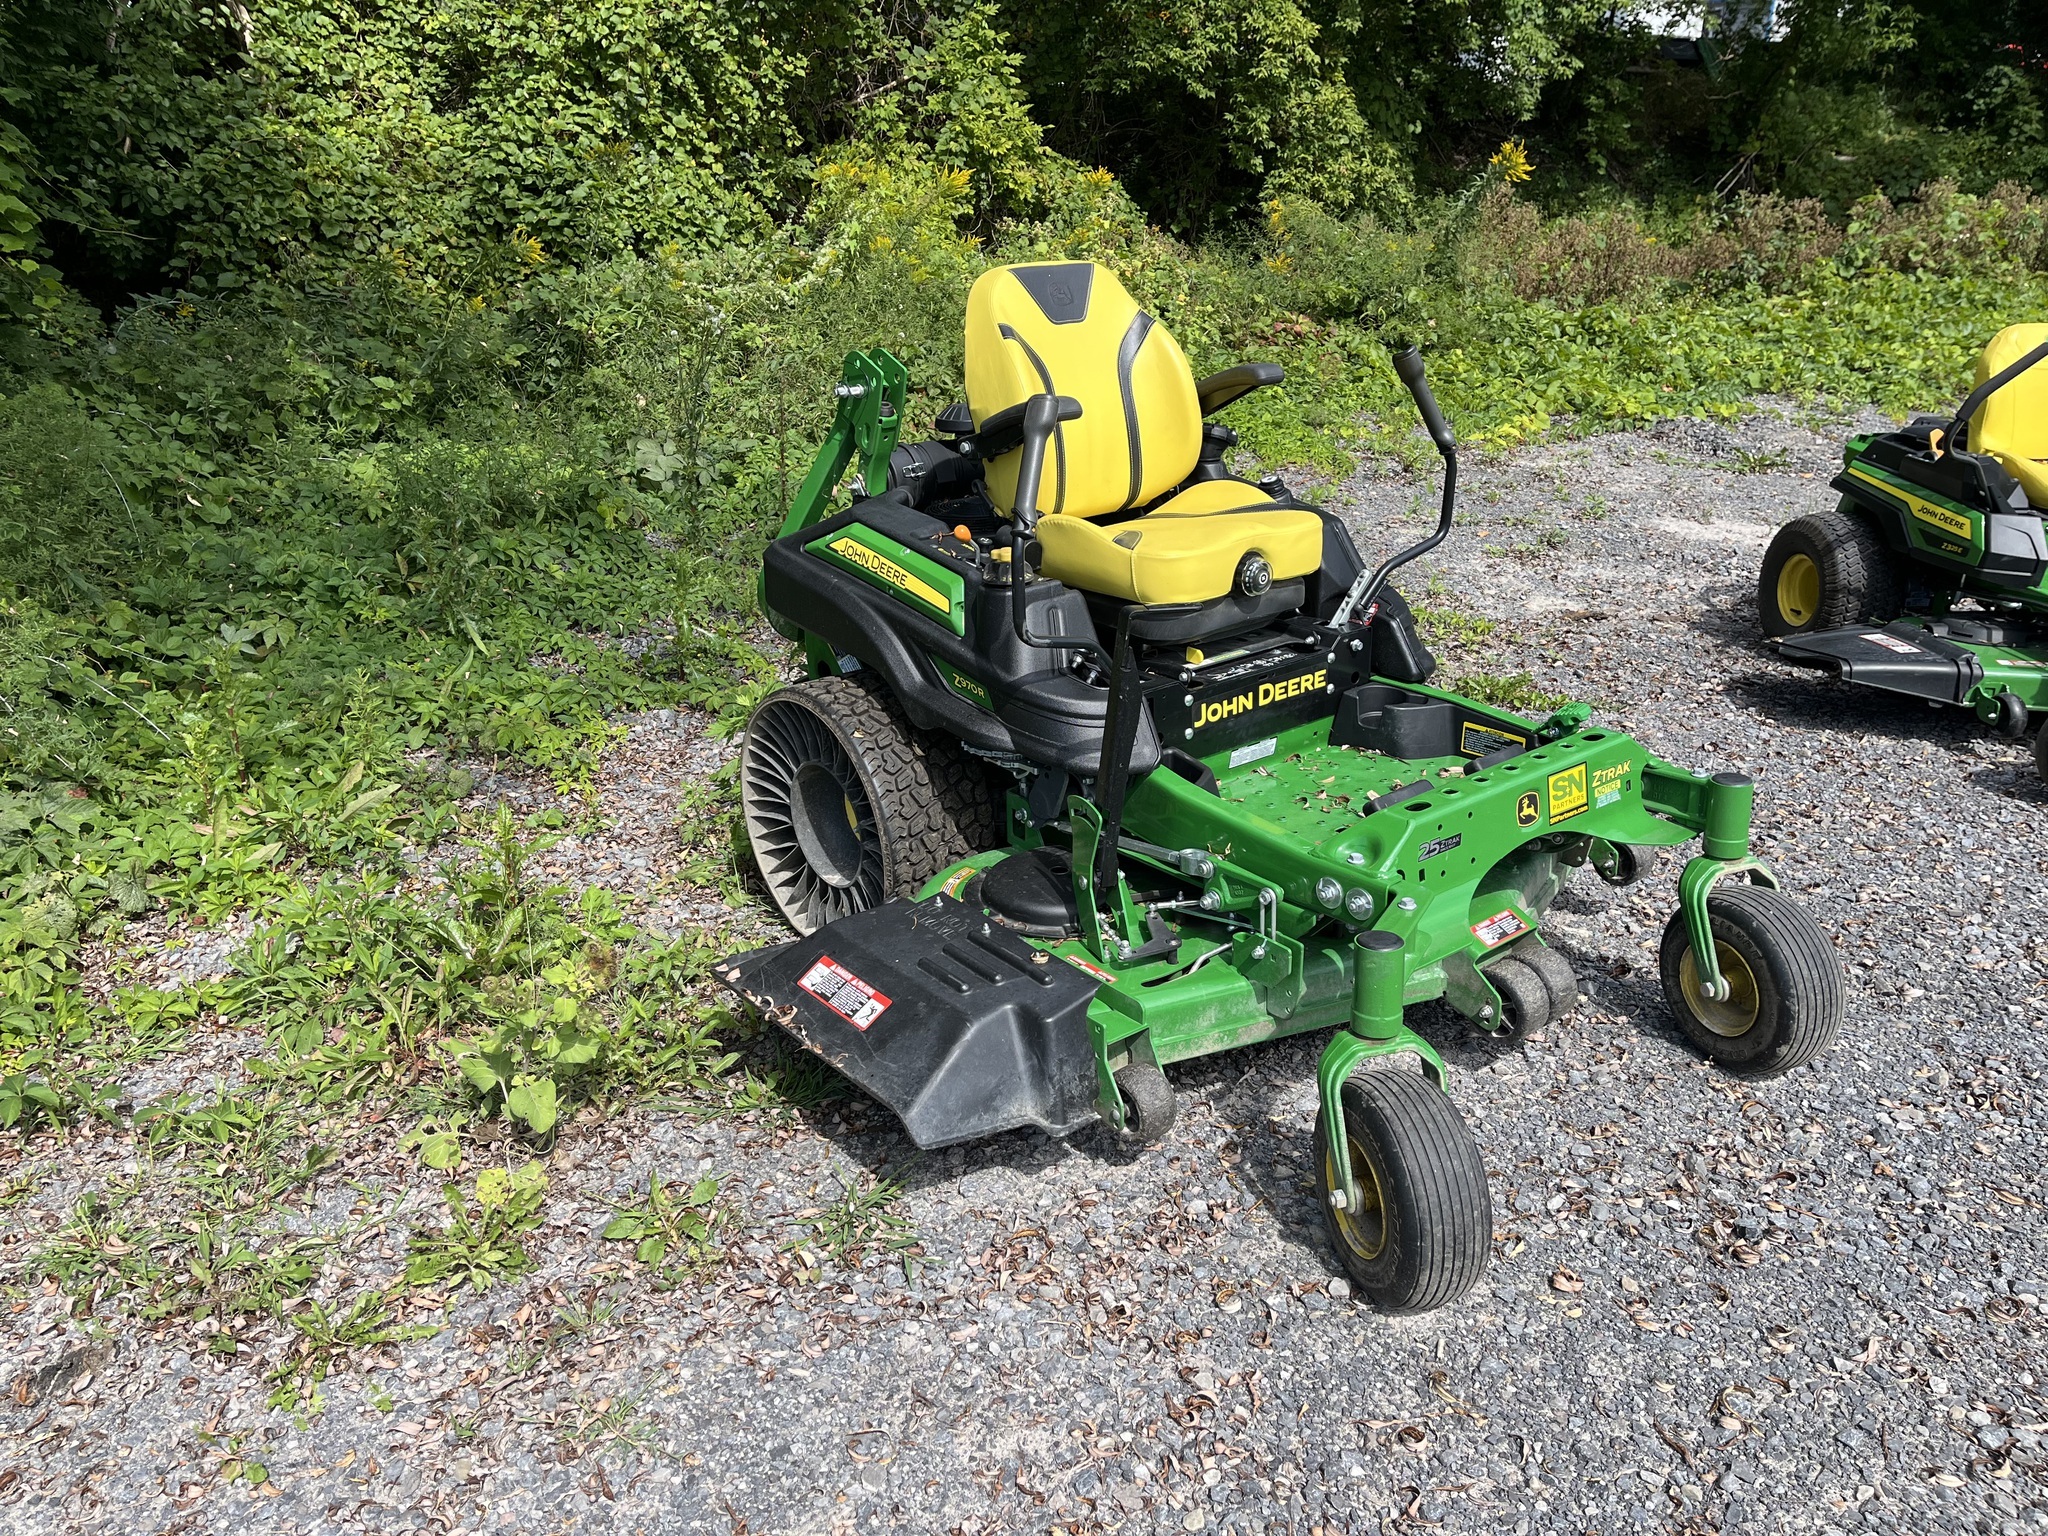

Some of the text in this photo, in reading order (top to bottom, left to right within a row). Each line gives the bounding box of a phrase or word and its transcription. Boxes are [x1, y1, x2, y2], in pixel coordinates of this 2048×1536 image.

[1917, 505, 1966, 530] JOHN DEERE
[840, 541, 908, 587] JOHN DEERE
[952, 672, 985, 699] Z970R
[1194, 669, 1327, 728] JOHN DEERE
[1592, 760, 1632, 788] ZTRAK
[1552, 794, 1585, 811] PARTNERS
[1418, 837, 1441, 862] 25
